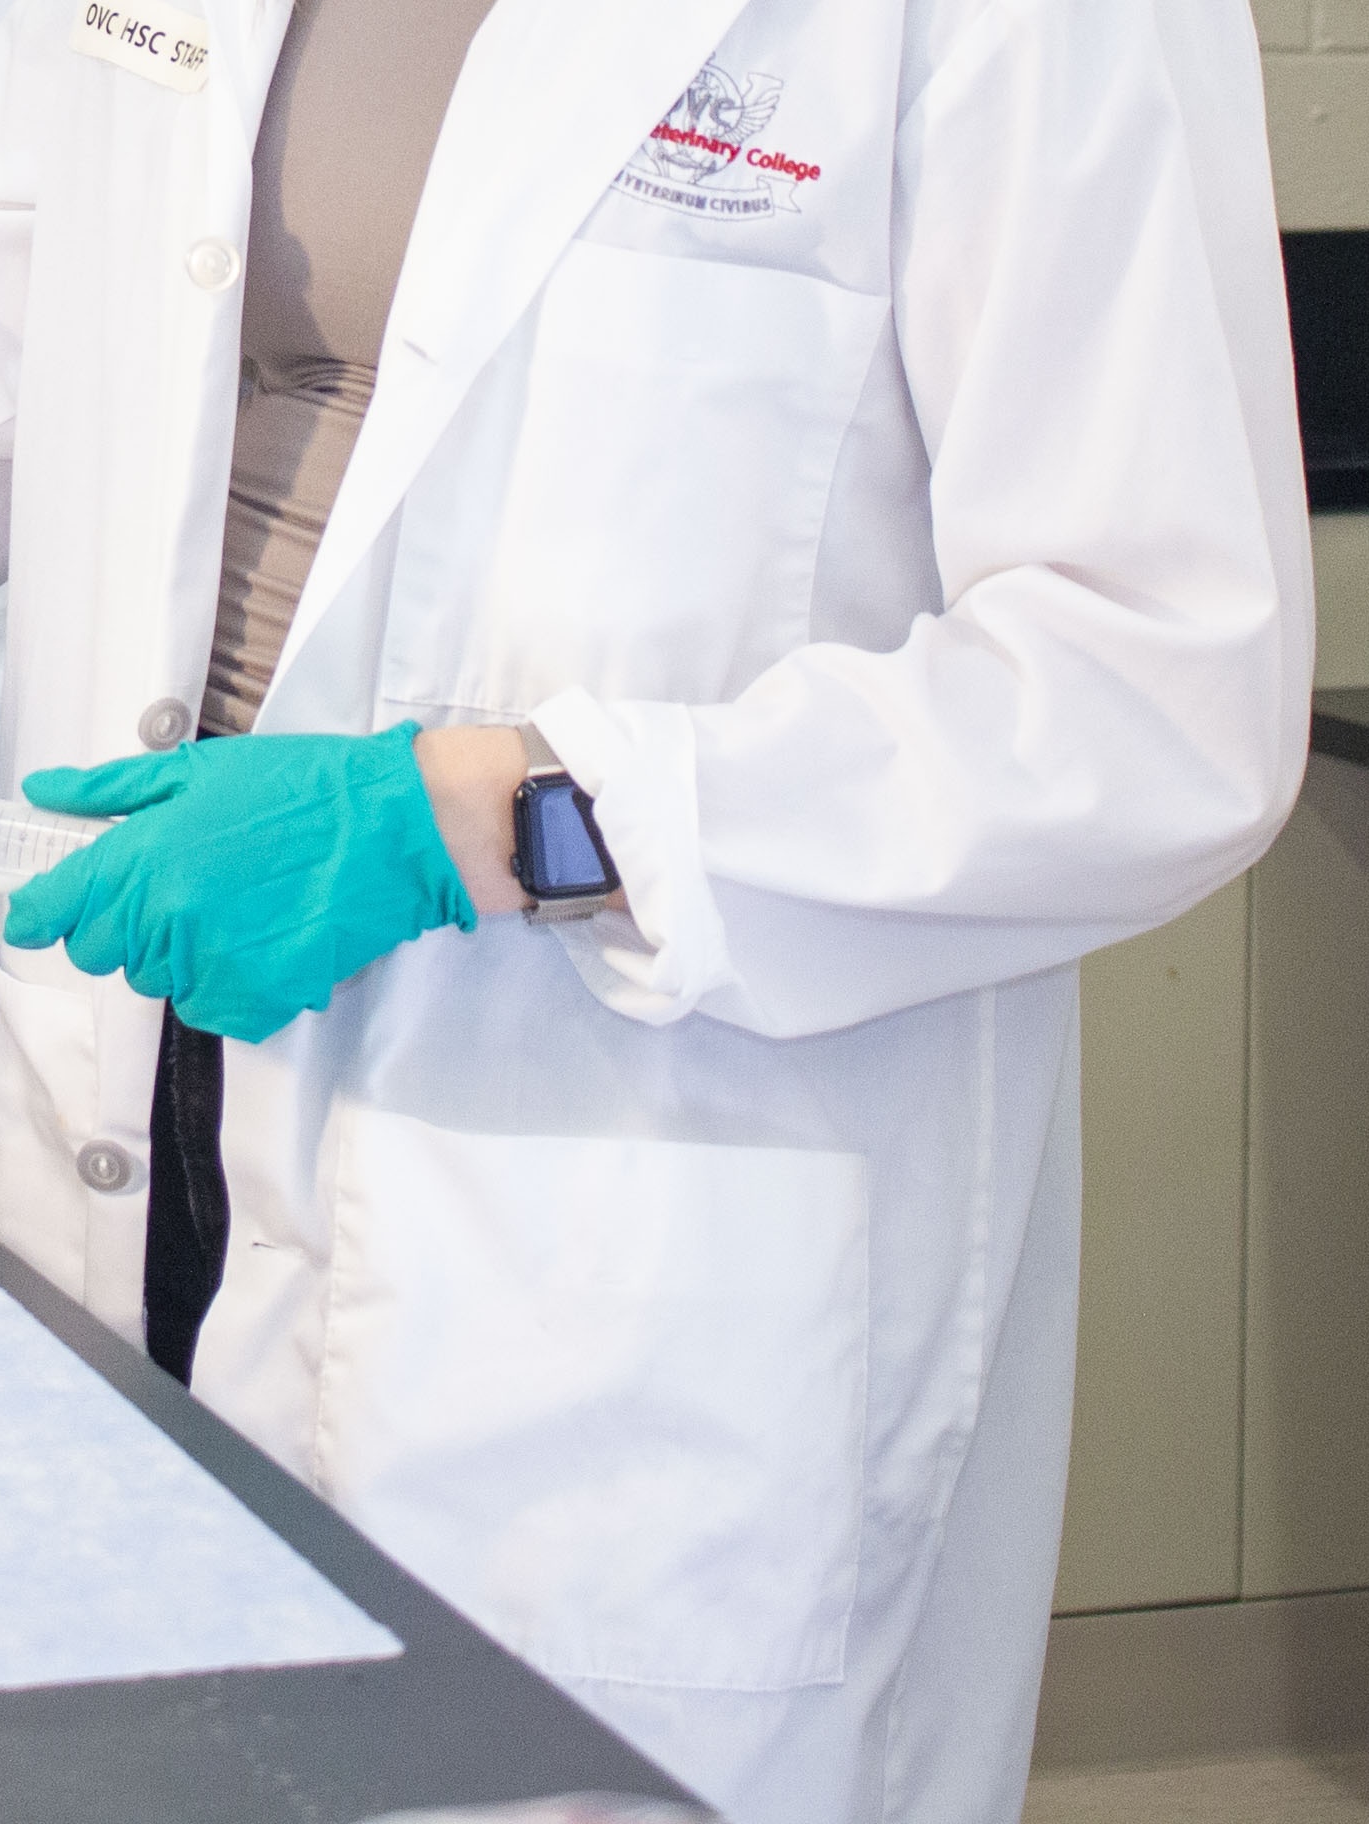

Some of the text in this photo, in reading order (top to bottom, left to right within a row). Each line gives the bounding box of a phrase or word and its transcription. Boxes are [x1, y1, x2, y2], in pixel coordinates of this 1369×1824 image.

[86, 2, 209, 72] OVC HSC STAFF
[649, 122, 821, 182] eterinary College
